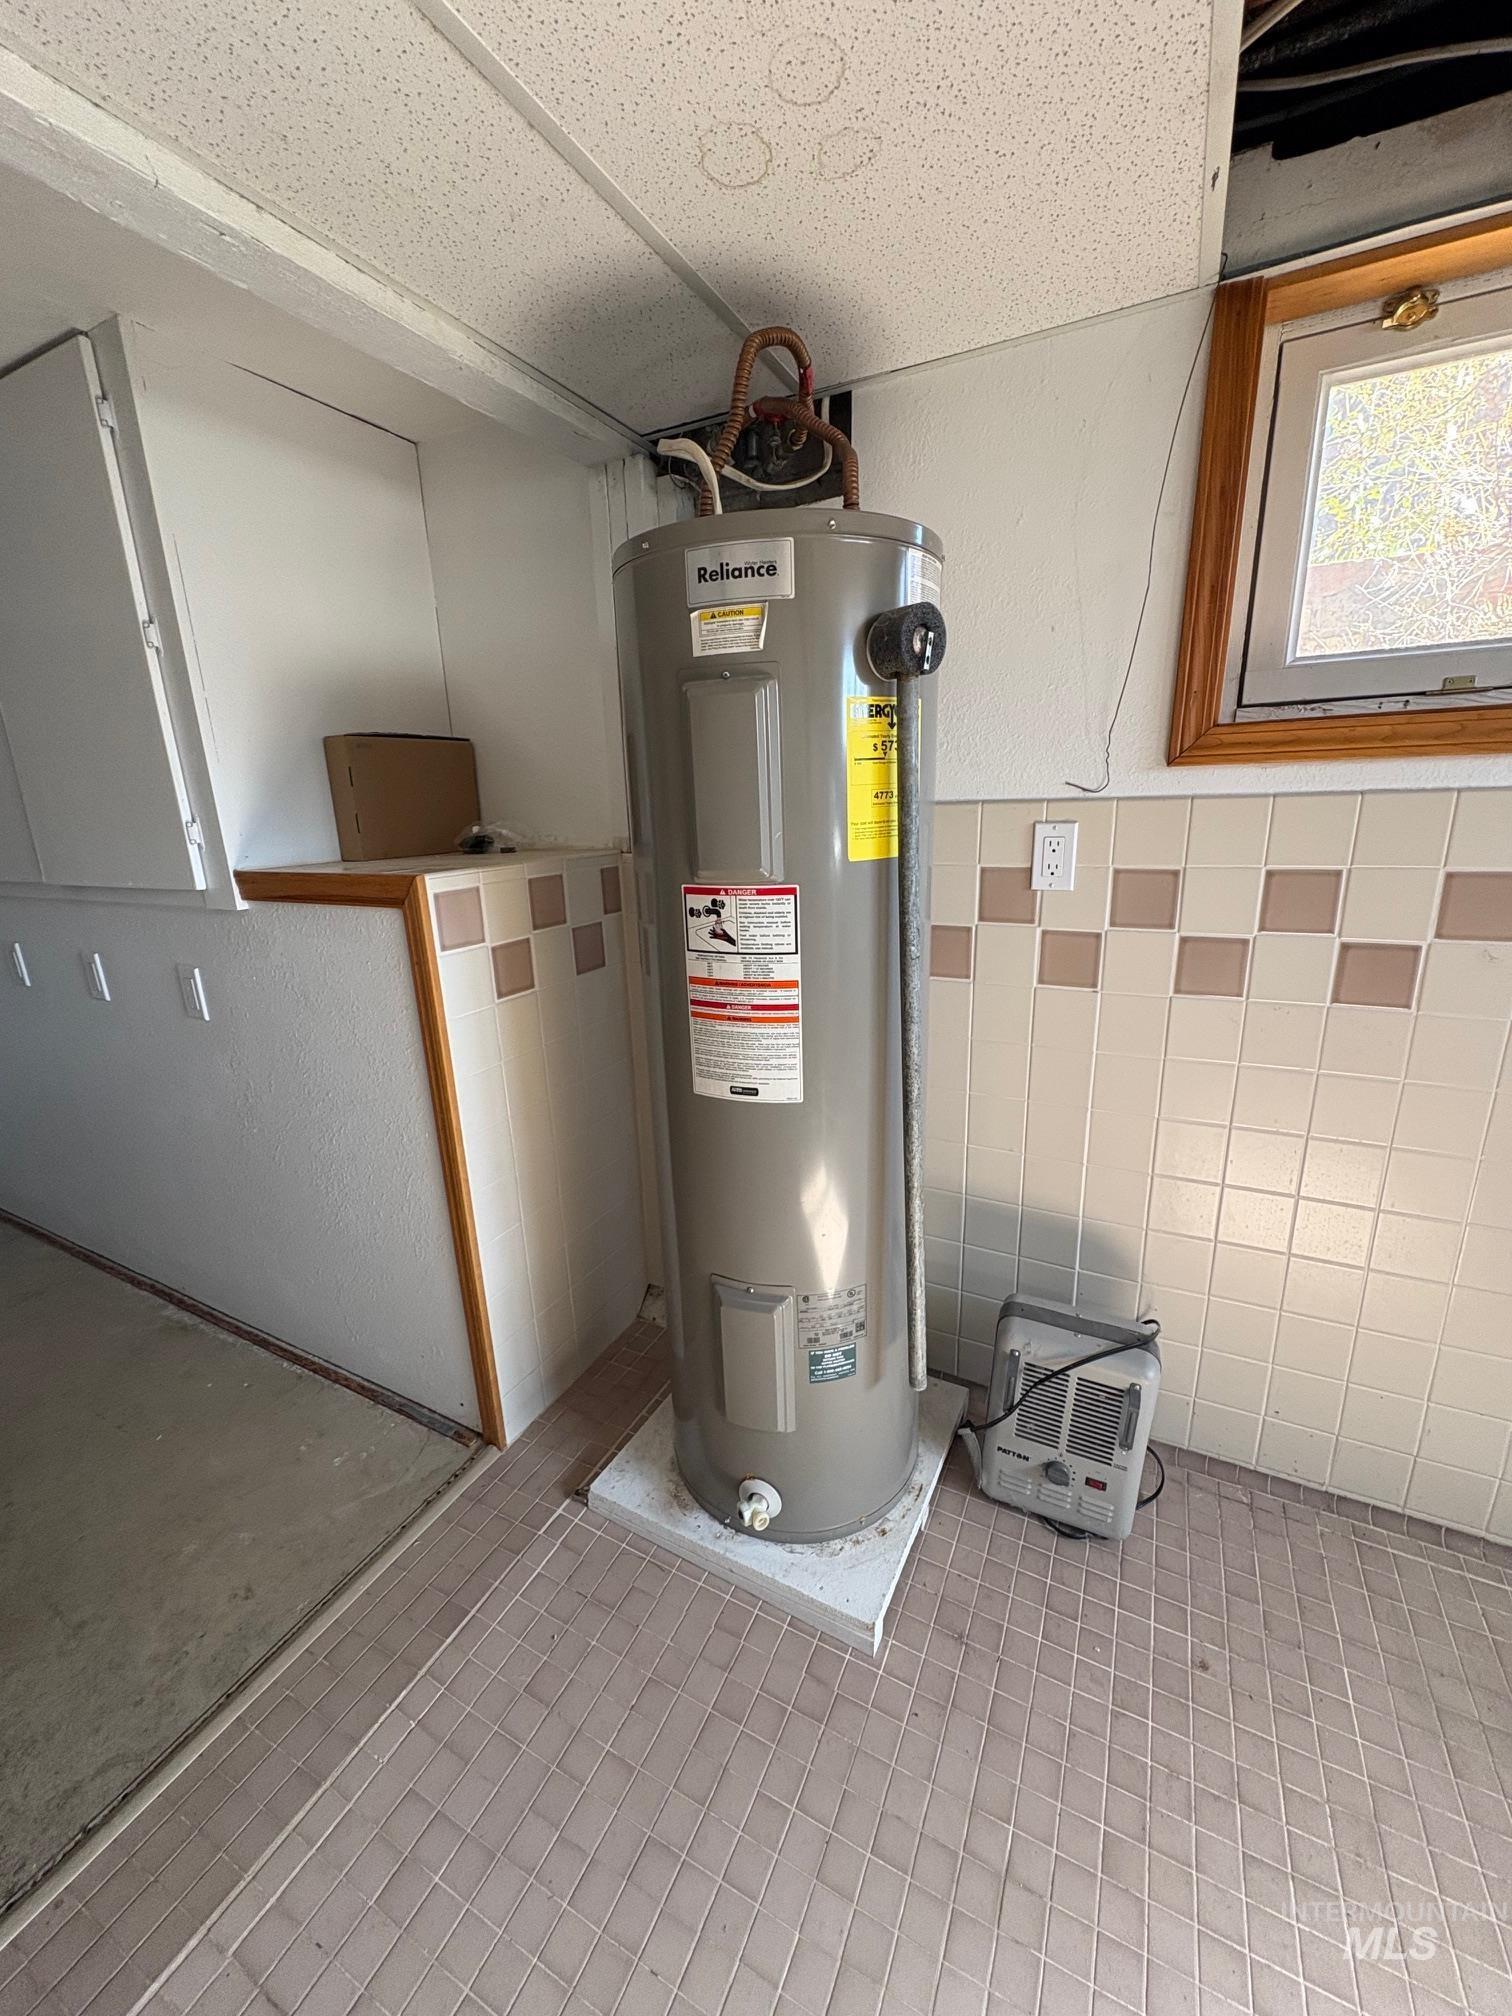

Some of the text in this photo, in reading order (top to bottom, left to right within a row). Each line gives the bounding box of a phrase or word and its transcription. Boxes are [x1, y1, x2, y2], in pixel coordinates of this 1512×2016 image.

[697, 561, 778, 584] Reliance
[717, 609, 744, 618] CAUTION
[873, 791, 894, 800] 4773
[997, 1446, 1030, 1462] PATTON
